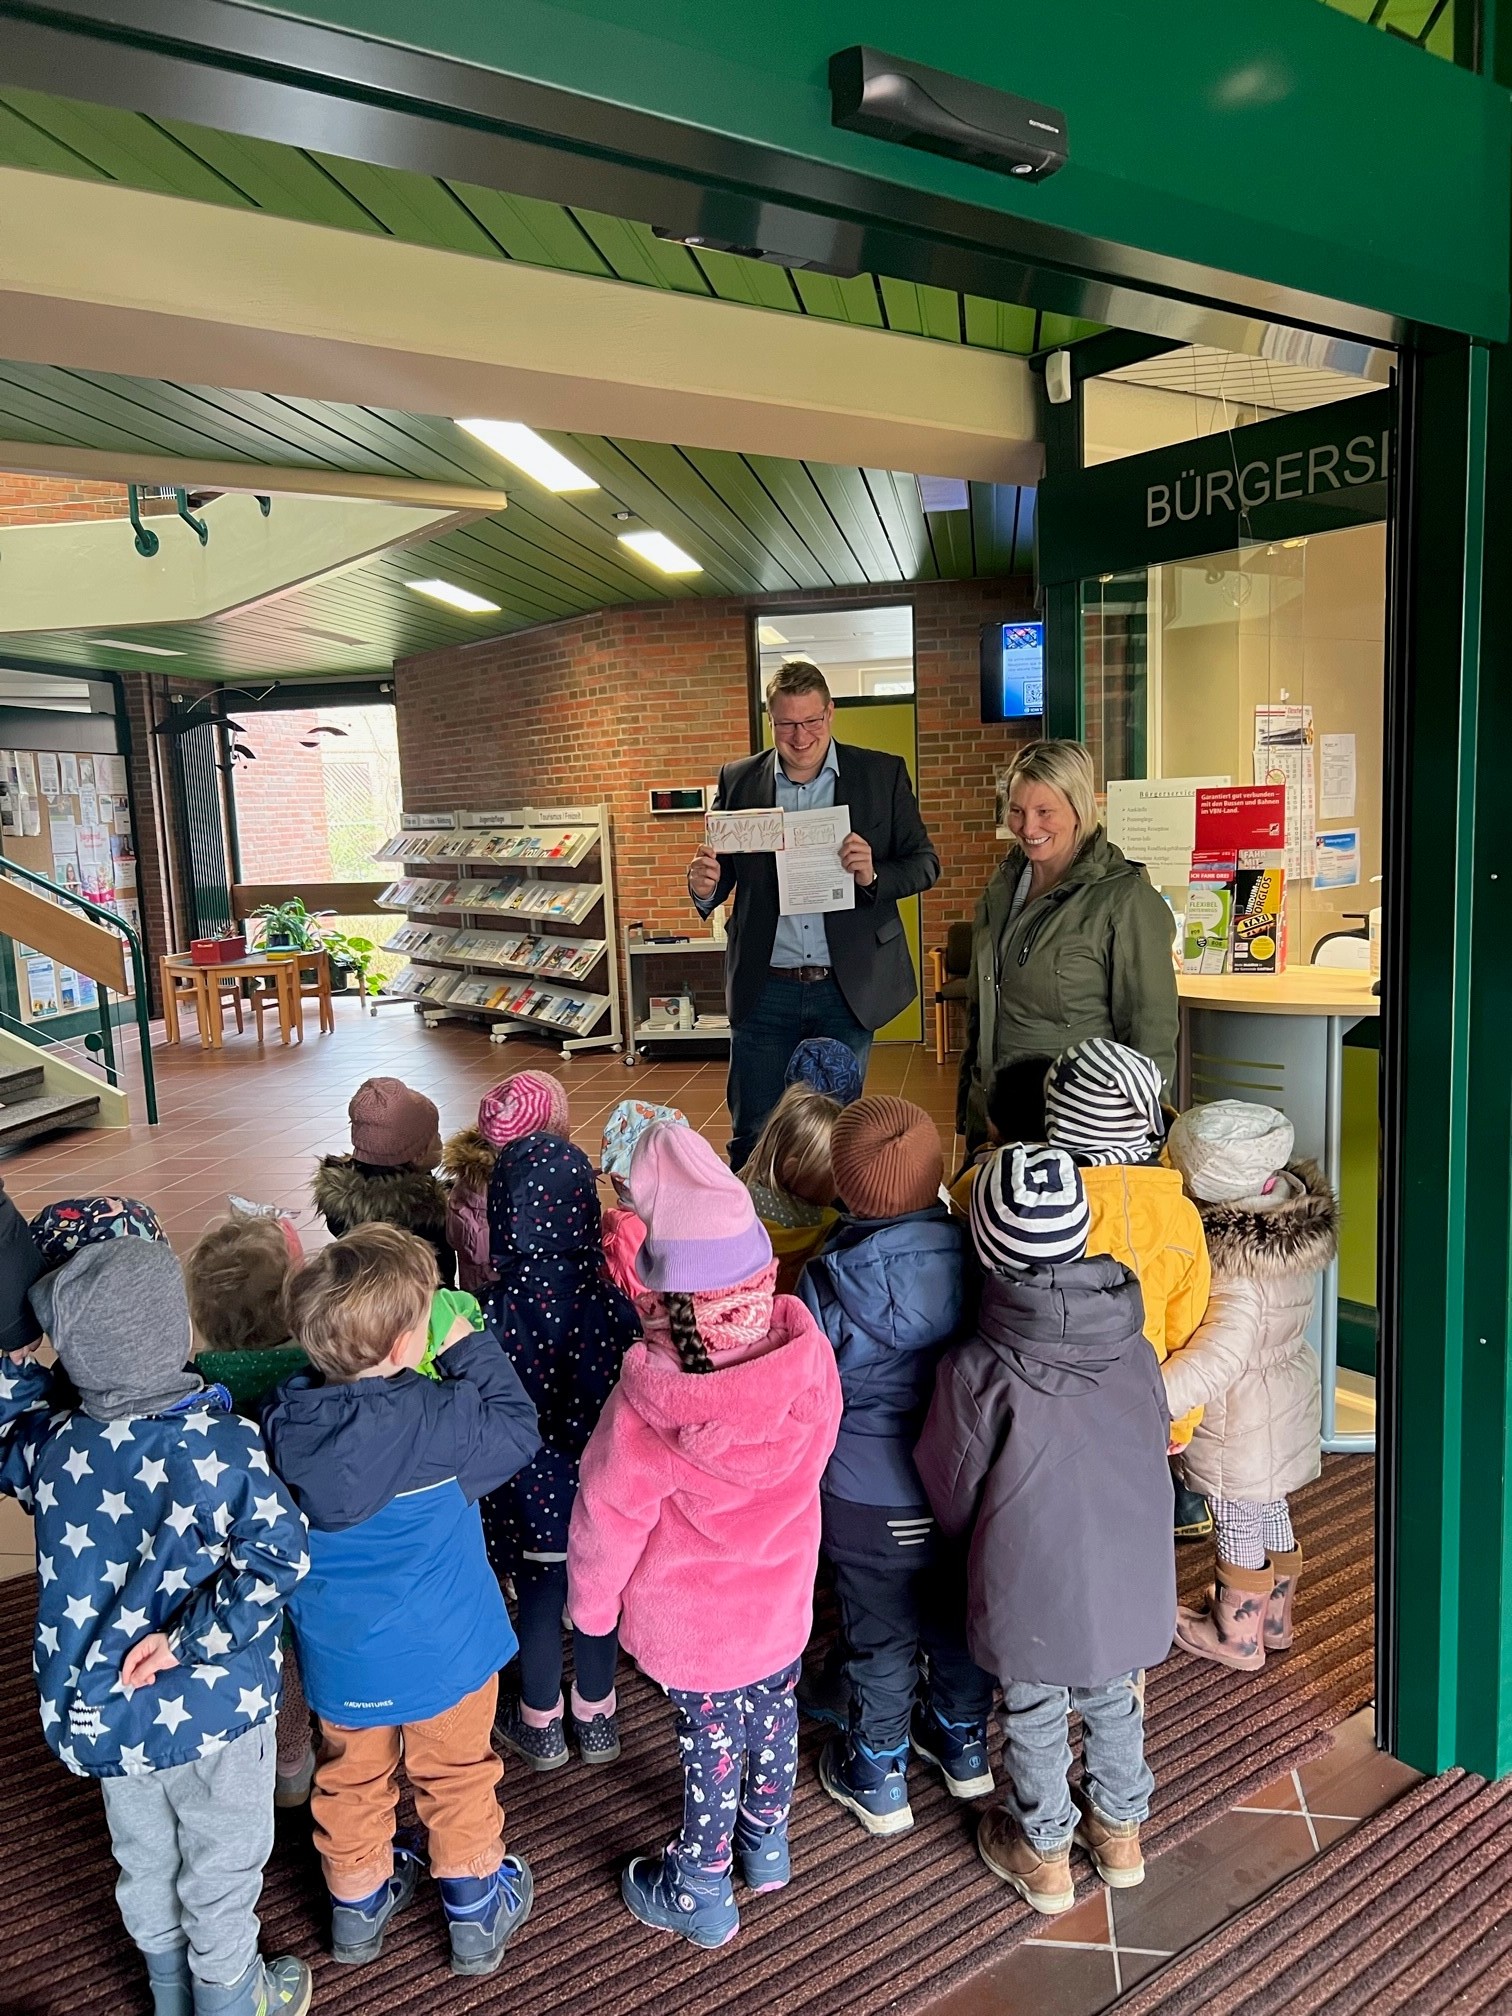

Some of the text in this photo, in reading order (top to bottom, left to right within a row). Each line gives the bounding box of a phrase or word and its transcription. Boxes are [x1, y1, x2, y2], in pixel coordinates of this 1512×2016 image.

[1139, 790, 1195, 799] Bürgerservice
[1201, 792, 1231, 800] Garantiert
[1232, 792, 1242, 800] gut
[1243, 791, 1274, 799] verbunden
[1255, 877, 1272, 914] ORGLOS
[1244, 914, 1269, 926] TAXI
